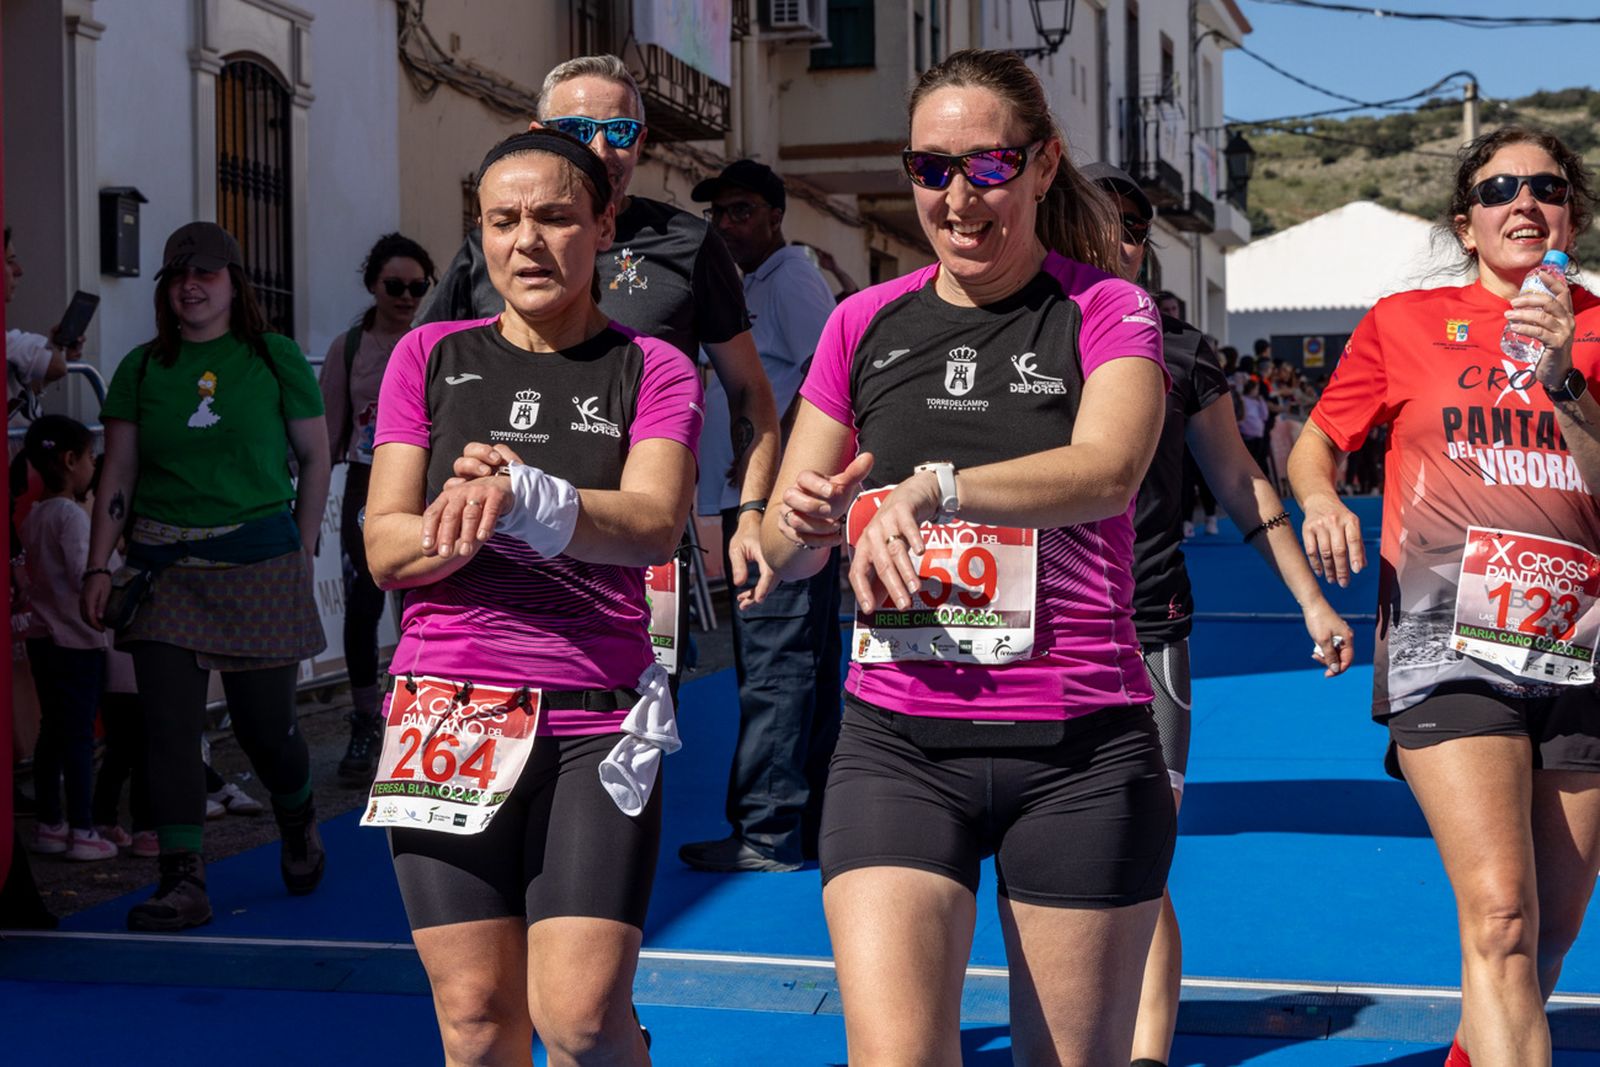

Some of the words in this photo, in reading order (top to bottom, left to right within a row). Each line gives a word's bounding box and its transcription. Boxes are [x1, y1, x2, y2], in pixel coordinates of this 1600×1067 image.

[1458, 365, 1538, 391] CRO
[1010, 383, 1067, 395] DEPORTES
[926, 398, 989, 408] TORREDELCAMPO
[490, 430, 550, 440] TORREDELCAMPO
[571, 421, 621, 438] DEPORTES
[1442, 406, 1567, 451] PANTA
[491, 436, 547, 444] AYUNTAMIENTO
[1448, 440, 1476, 460] DEL
[981, 534, 1001, 545] DEL
[1488, 538, 1516, 566] X
[1517, 551, 1589, 581] CROSS
[883, 546, 998, 608] 59
[1485, 564, 1572, 594] PANTANO
[876, 613, 909, 626] IRENE
[953, 611, 1008, 626] MORAL
[1488, 581, 1580, 641] 123
[1459, 626, 1496, 641] MARIA
[1499, 632, 1533, 647] CAÑO
[406, 687, 431, 711] X
[391, 727, 497, 789] 264
[374, 783, 406, 795] TERESA
